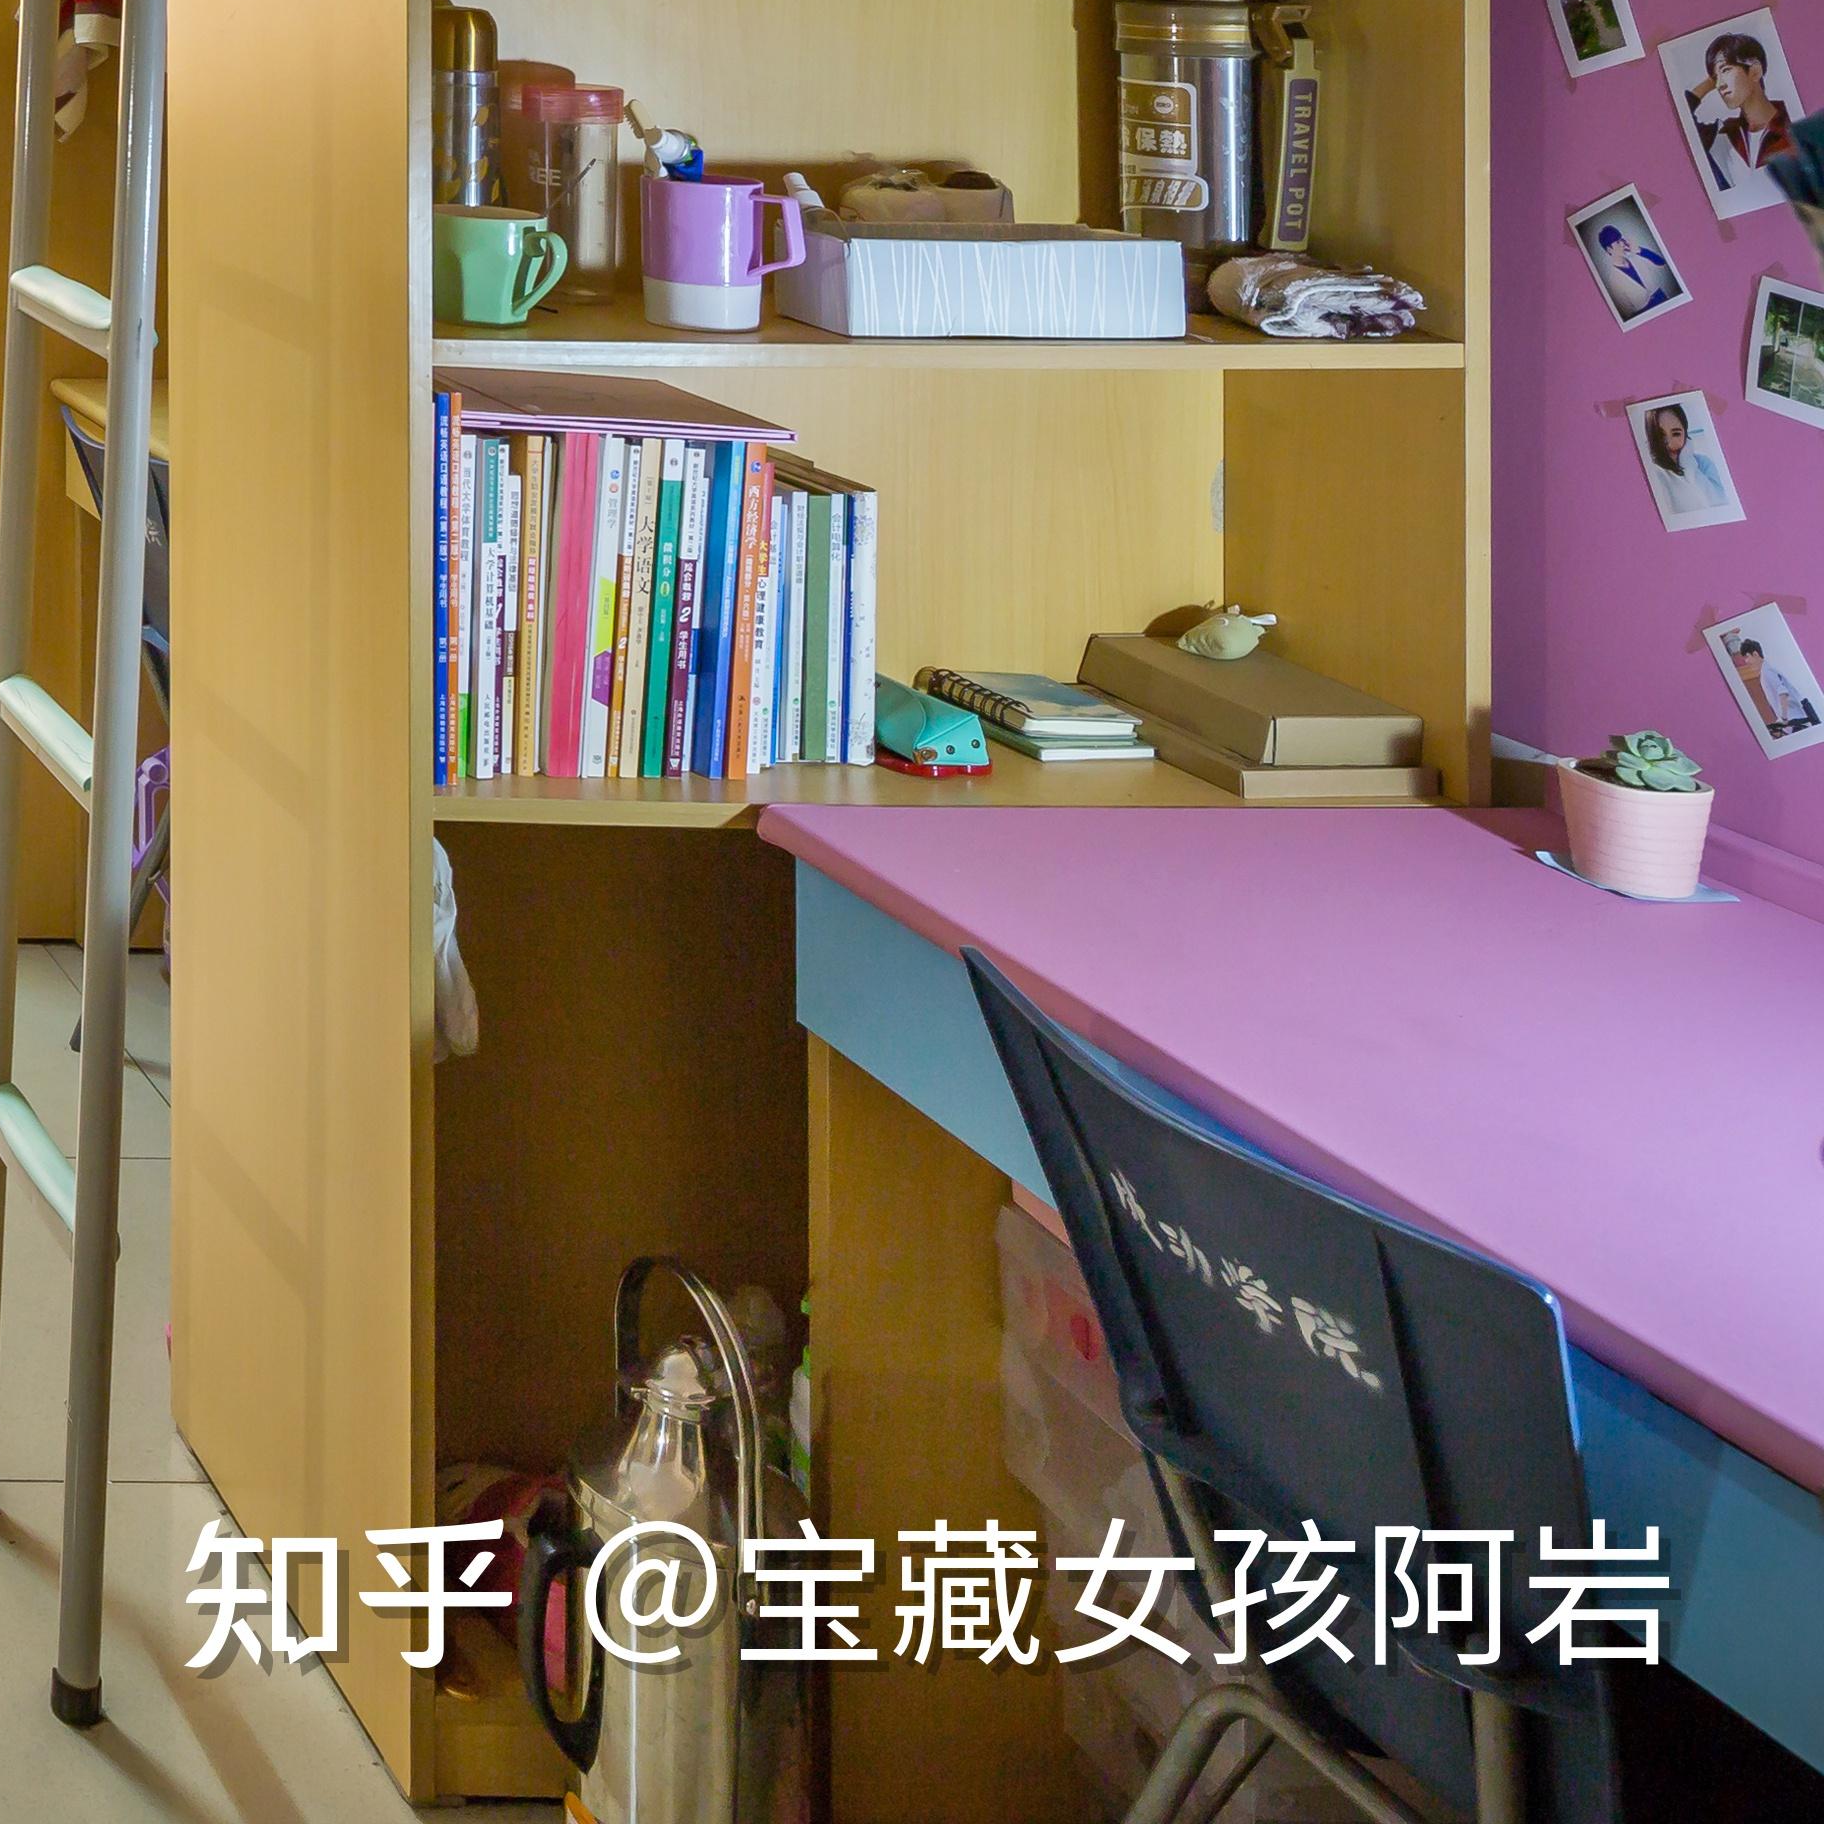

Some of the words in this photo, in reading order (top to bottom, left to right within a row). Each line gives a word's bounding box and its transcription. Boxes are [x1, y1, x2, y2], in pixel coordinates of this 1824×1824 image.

[1290, 92, 1313, 178] TRAVEL
[1284, 186, 1306, 230] POT
[744, 485, 760, 550] 西方经济学
[831, 513, 842, 561] 会计电算化
[636, 515, 655, 595] 大学语文
[662, 542, 673, 577] 微积分
[758, 540, 769, 576] 大学生
[484, 548, 496, 630] 大学计算机基础
[681, 563, 694, 602] 综合教程
[679, 606, 692, 623] 2
[754, 579, 767, 650] 心理健康教育
[618, 637, 627, 650] 2
[677, 631, 689, 669] 学生用书
